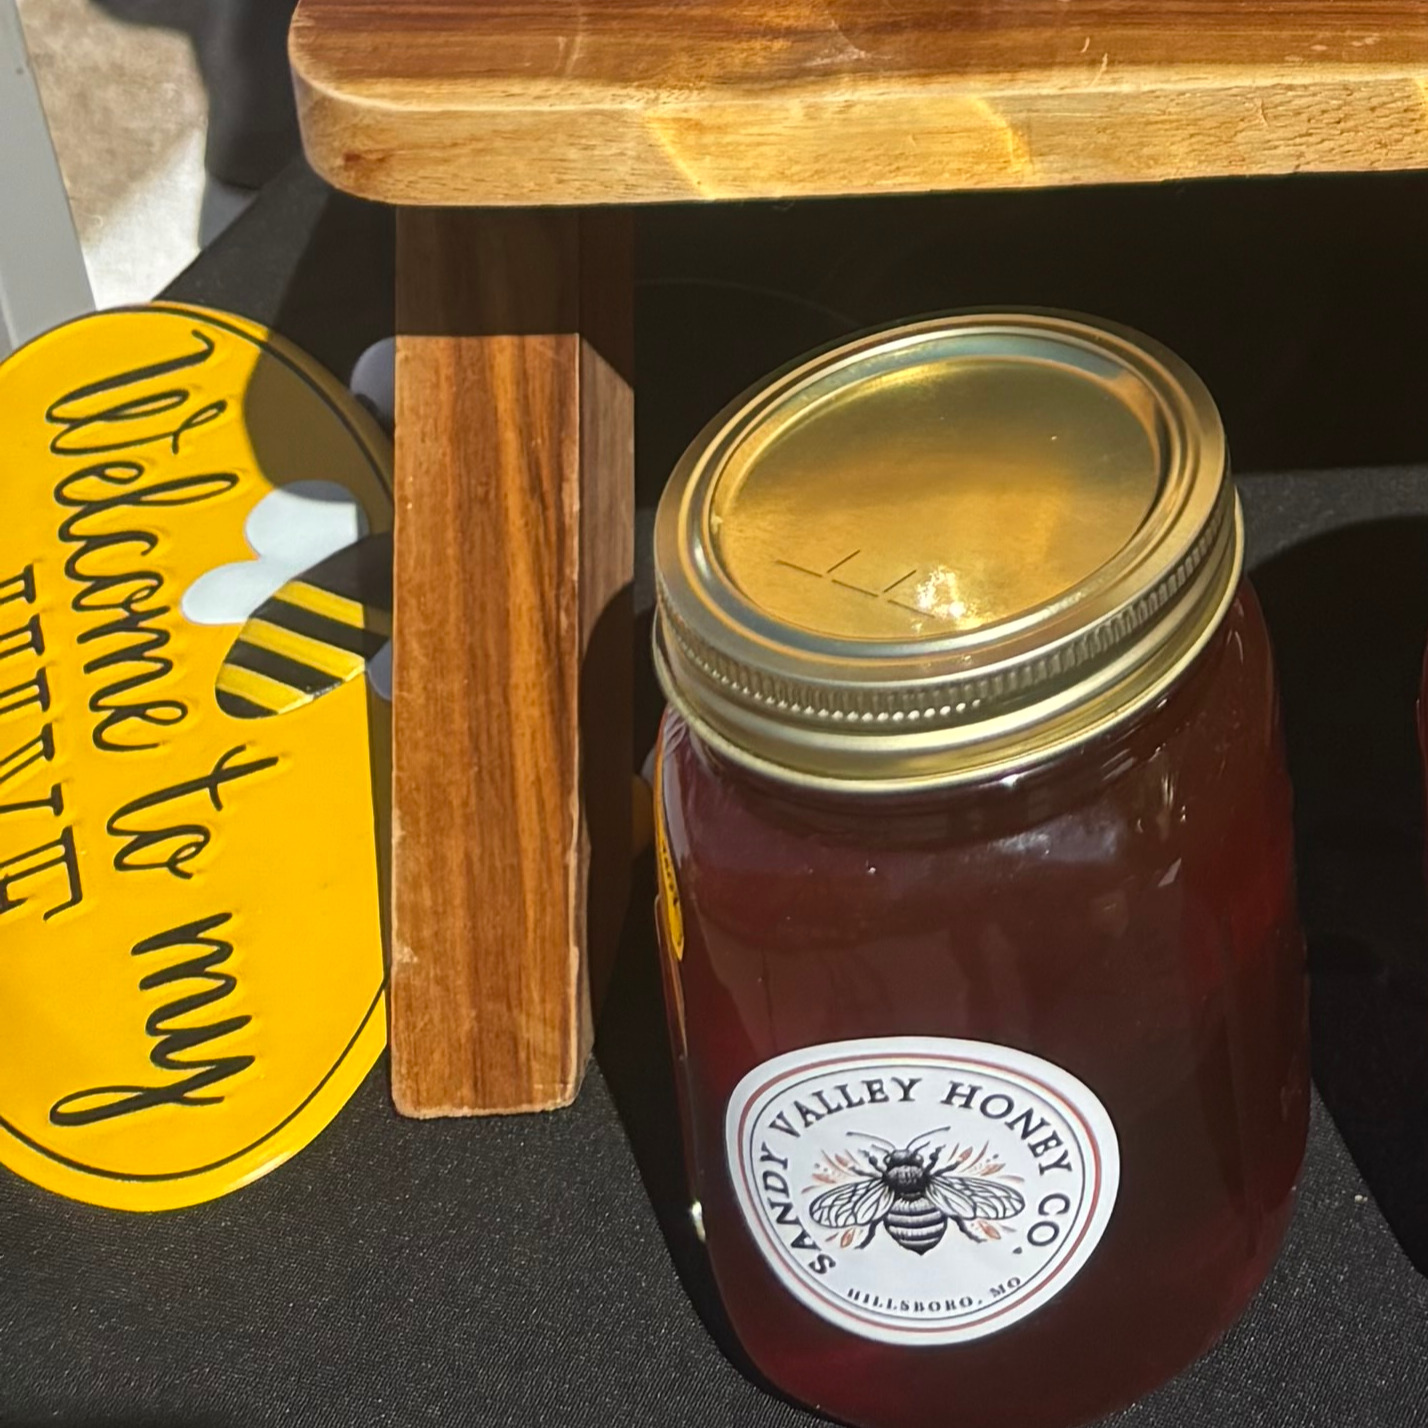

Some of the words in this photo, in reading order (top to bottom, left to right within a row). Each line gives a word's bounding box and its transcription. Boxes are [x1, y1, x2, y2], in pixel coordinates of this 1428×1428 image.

[44, 326, 240, 756] Welcome
[104, 742, 279, 881] to
[47, 908, 258, 1129] my
[767, 1076, 923, 1139] VALLEY
[939, 1080, 1073, 1177] HONEY
[759, 1141, 838, 1276] SANDY
[1011, 1191, 1072, 1256] CO.
[846, 1287, 984, 1313] HILLSBORO,
[989, 1275, 1022, 1299] MO
